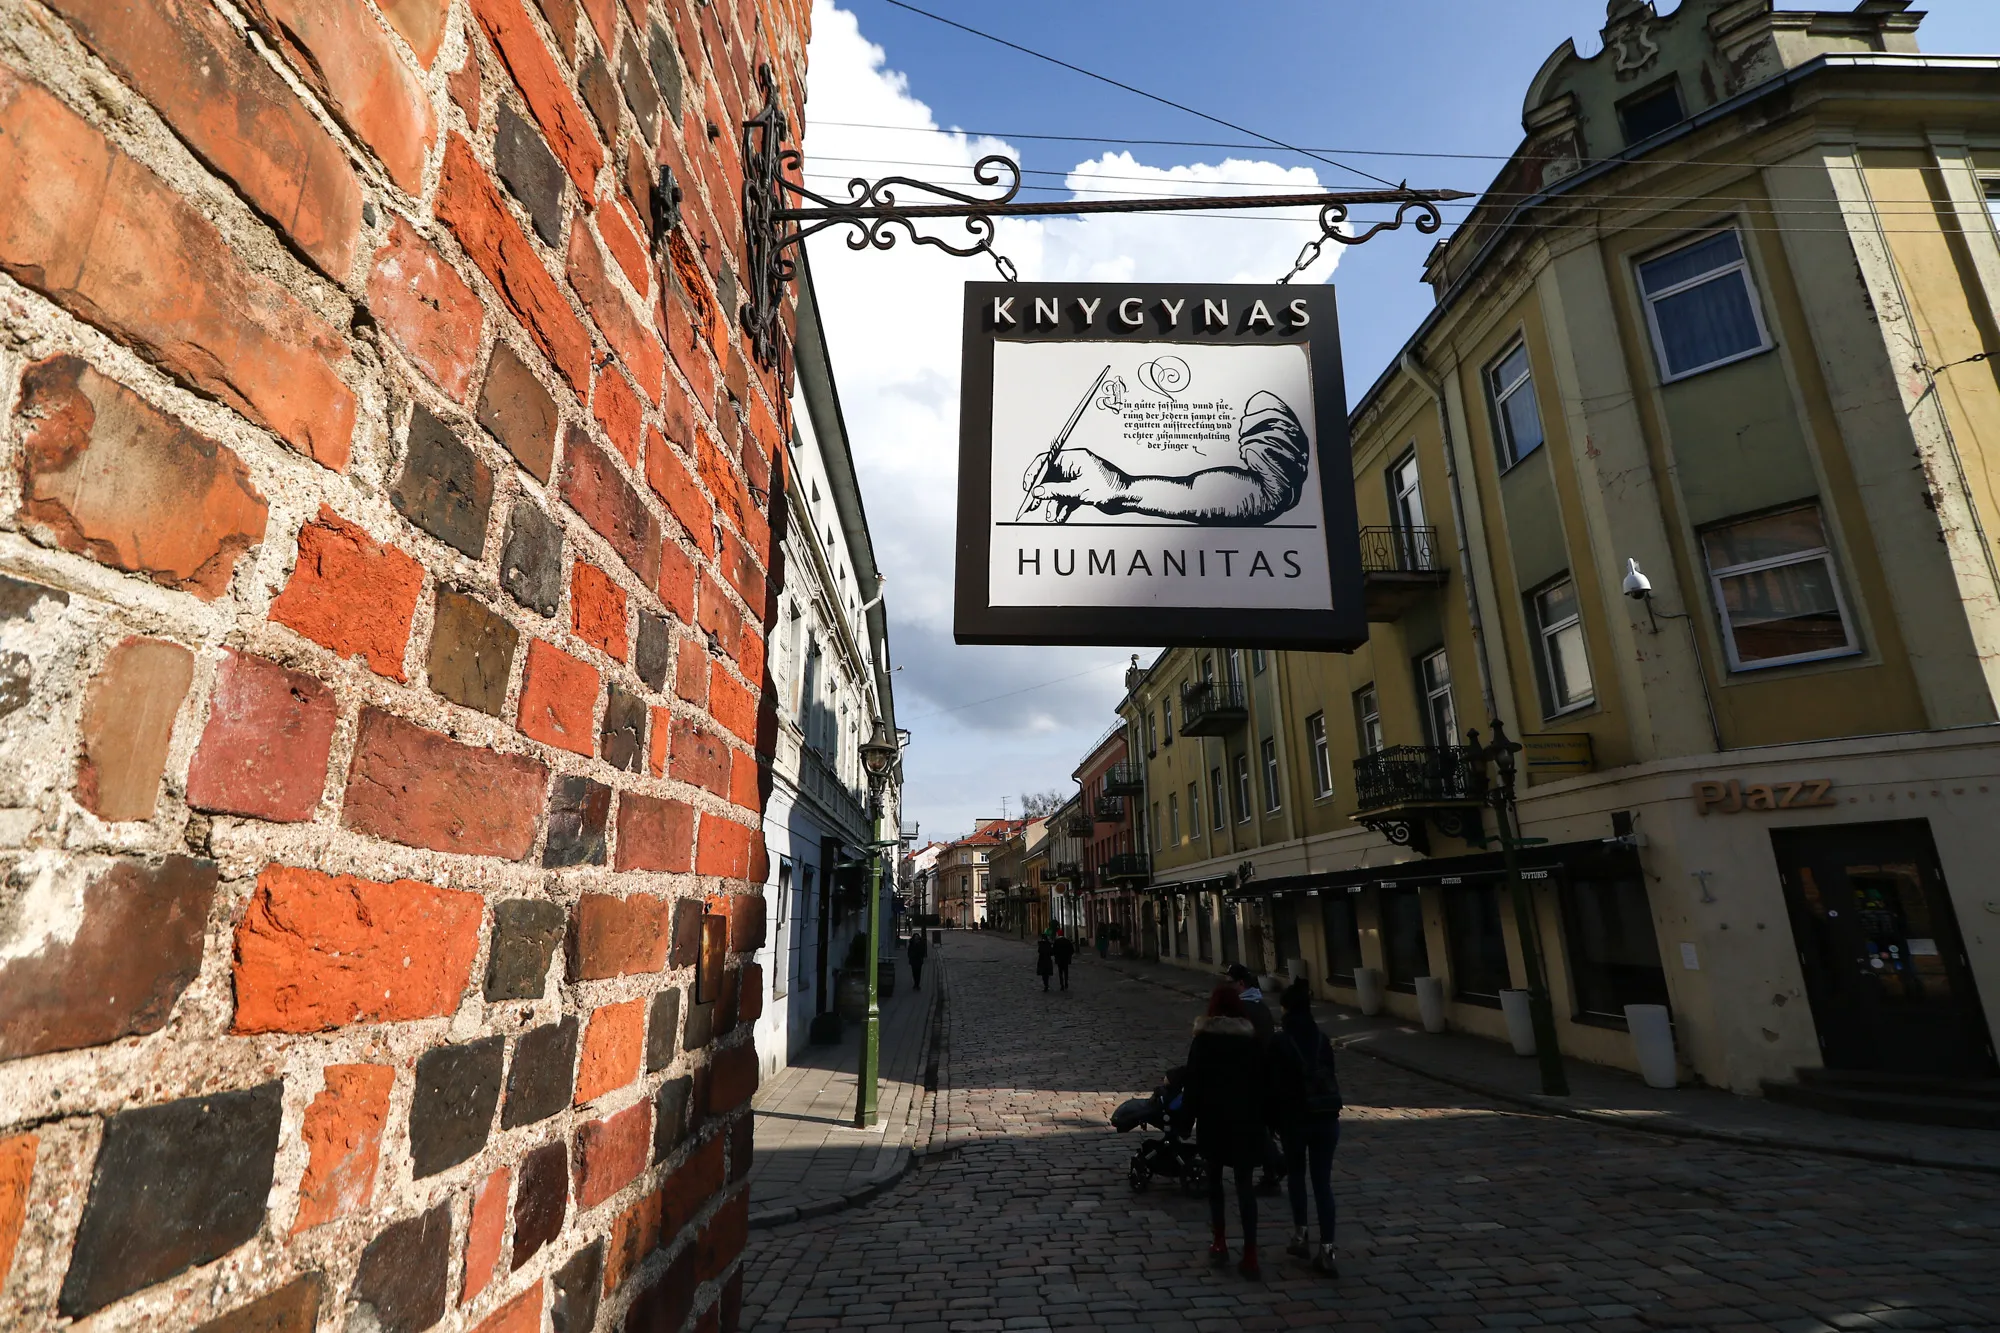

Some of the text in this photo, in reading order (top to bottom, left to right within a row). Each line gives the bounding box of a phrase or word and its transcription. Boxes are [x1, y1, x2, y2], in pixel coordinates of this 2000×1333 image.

[993, 296, 1311, 328] KNYGYNAS
[1147, 441, 1161, 449] der
[1017, 548, 1303, 578] HUMANITAS
